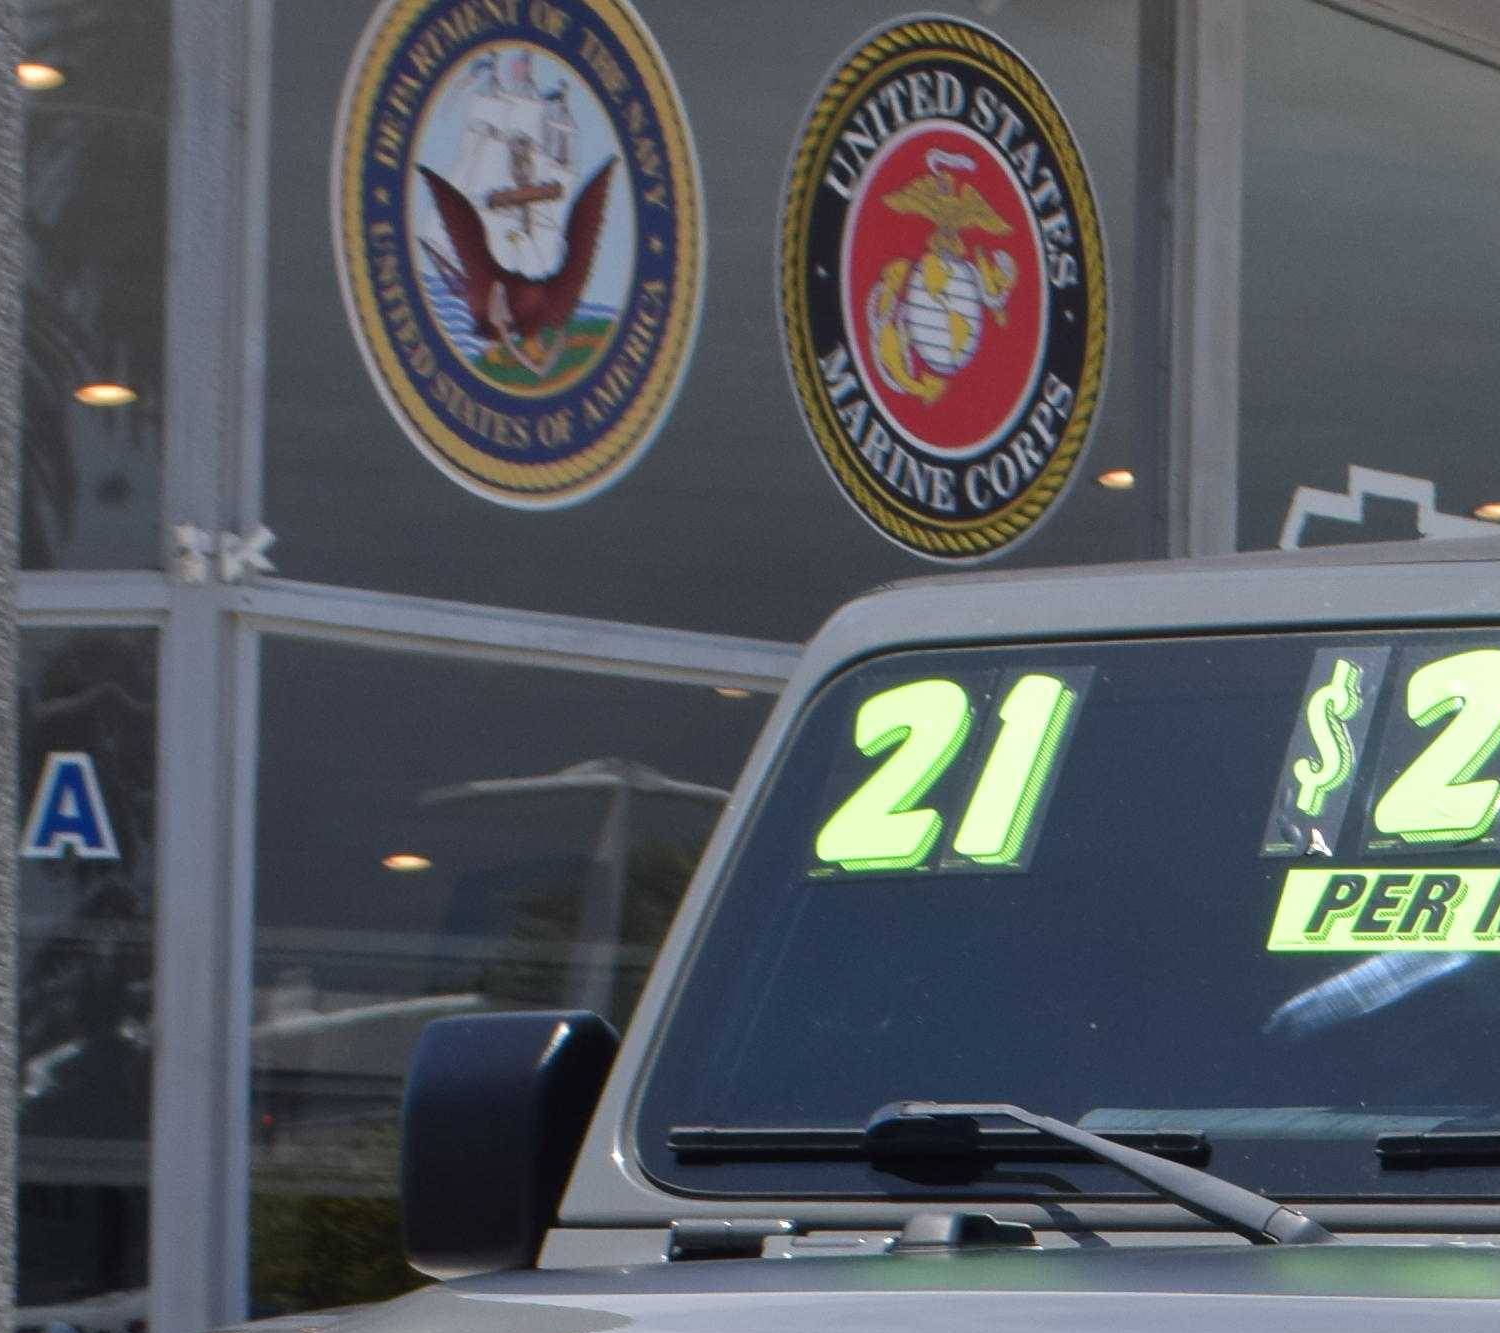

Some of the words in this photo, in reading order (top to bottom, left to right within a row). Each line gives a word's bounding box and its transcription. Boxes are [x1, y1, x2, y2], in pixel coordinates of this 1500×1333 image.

[529, 0, 570, 39] OF
[624, 100, 669, 209] NAVY
[825, 70, 966, 203] UNITED
[970, 85, 1080, 290] STATES
[368, 217, 440, 375] UNITED
[430, 367, 533, 452] STATES
[537, 405, 575, 450] OF
[582, 277, 667, 430] AMERICA
[819, 340, 957, 514] MARINE
[964, 373, 1076, 511] CORPS
[816, 674, 1076, 872] 21
[1303, 873, 1467, 942] PER
